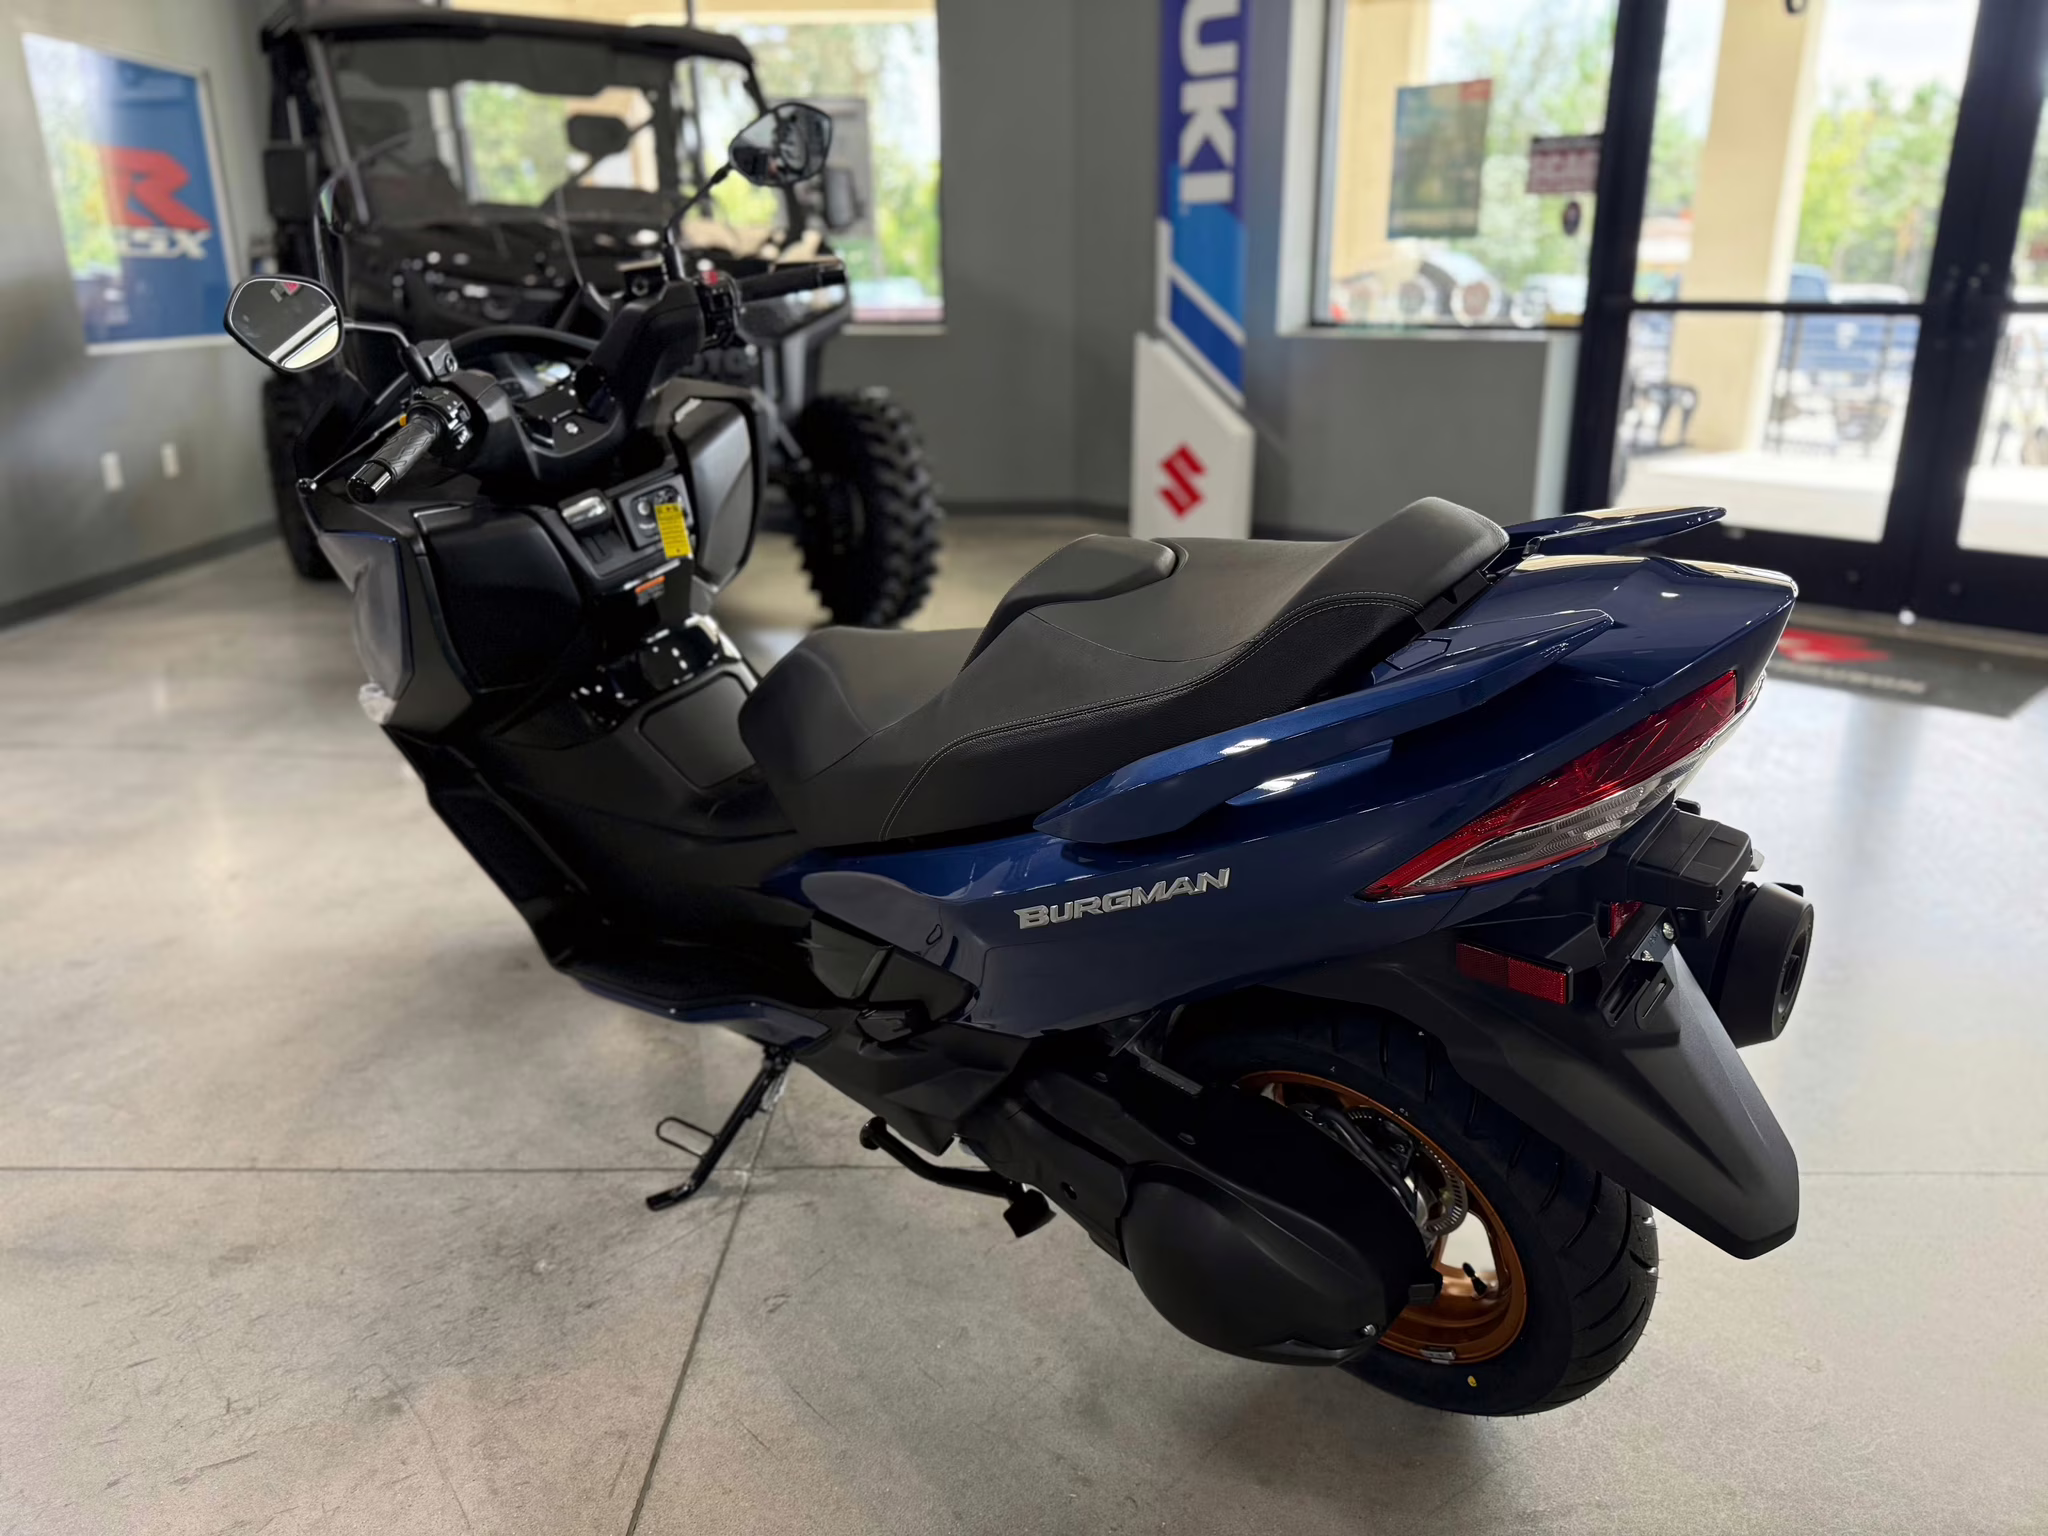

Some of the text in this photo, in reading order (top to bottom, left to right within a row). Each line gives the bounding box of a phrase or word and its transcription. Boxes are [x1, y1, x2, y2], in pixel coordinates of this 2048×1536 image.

[1179, 0, 1240, 204] UKI
[98, 146, 212, 230] R
[1013, 867, 1230, 929] BURGMAN
